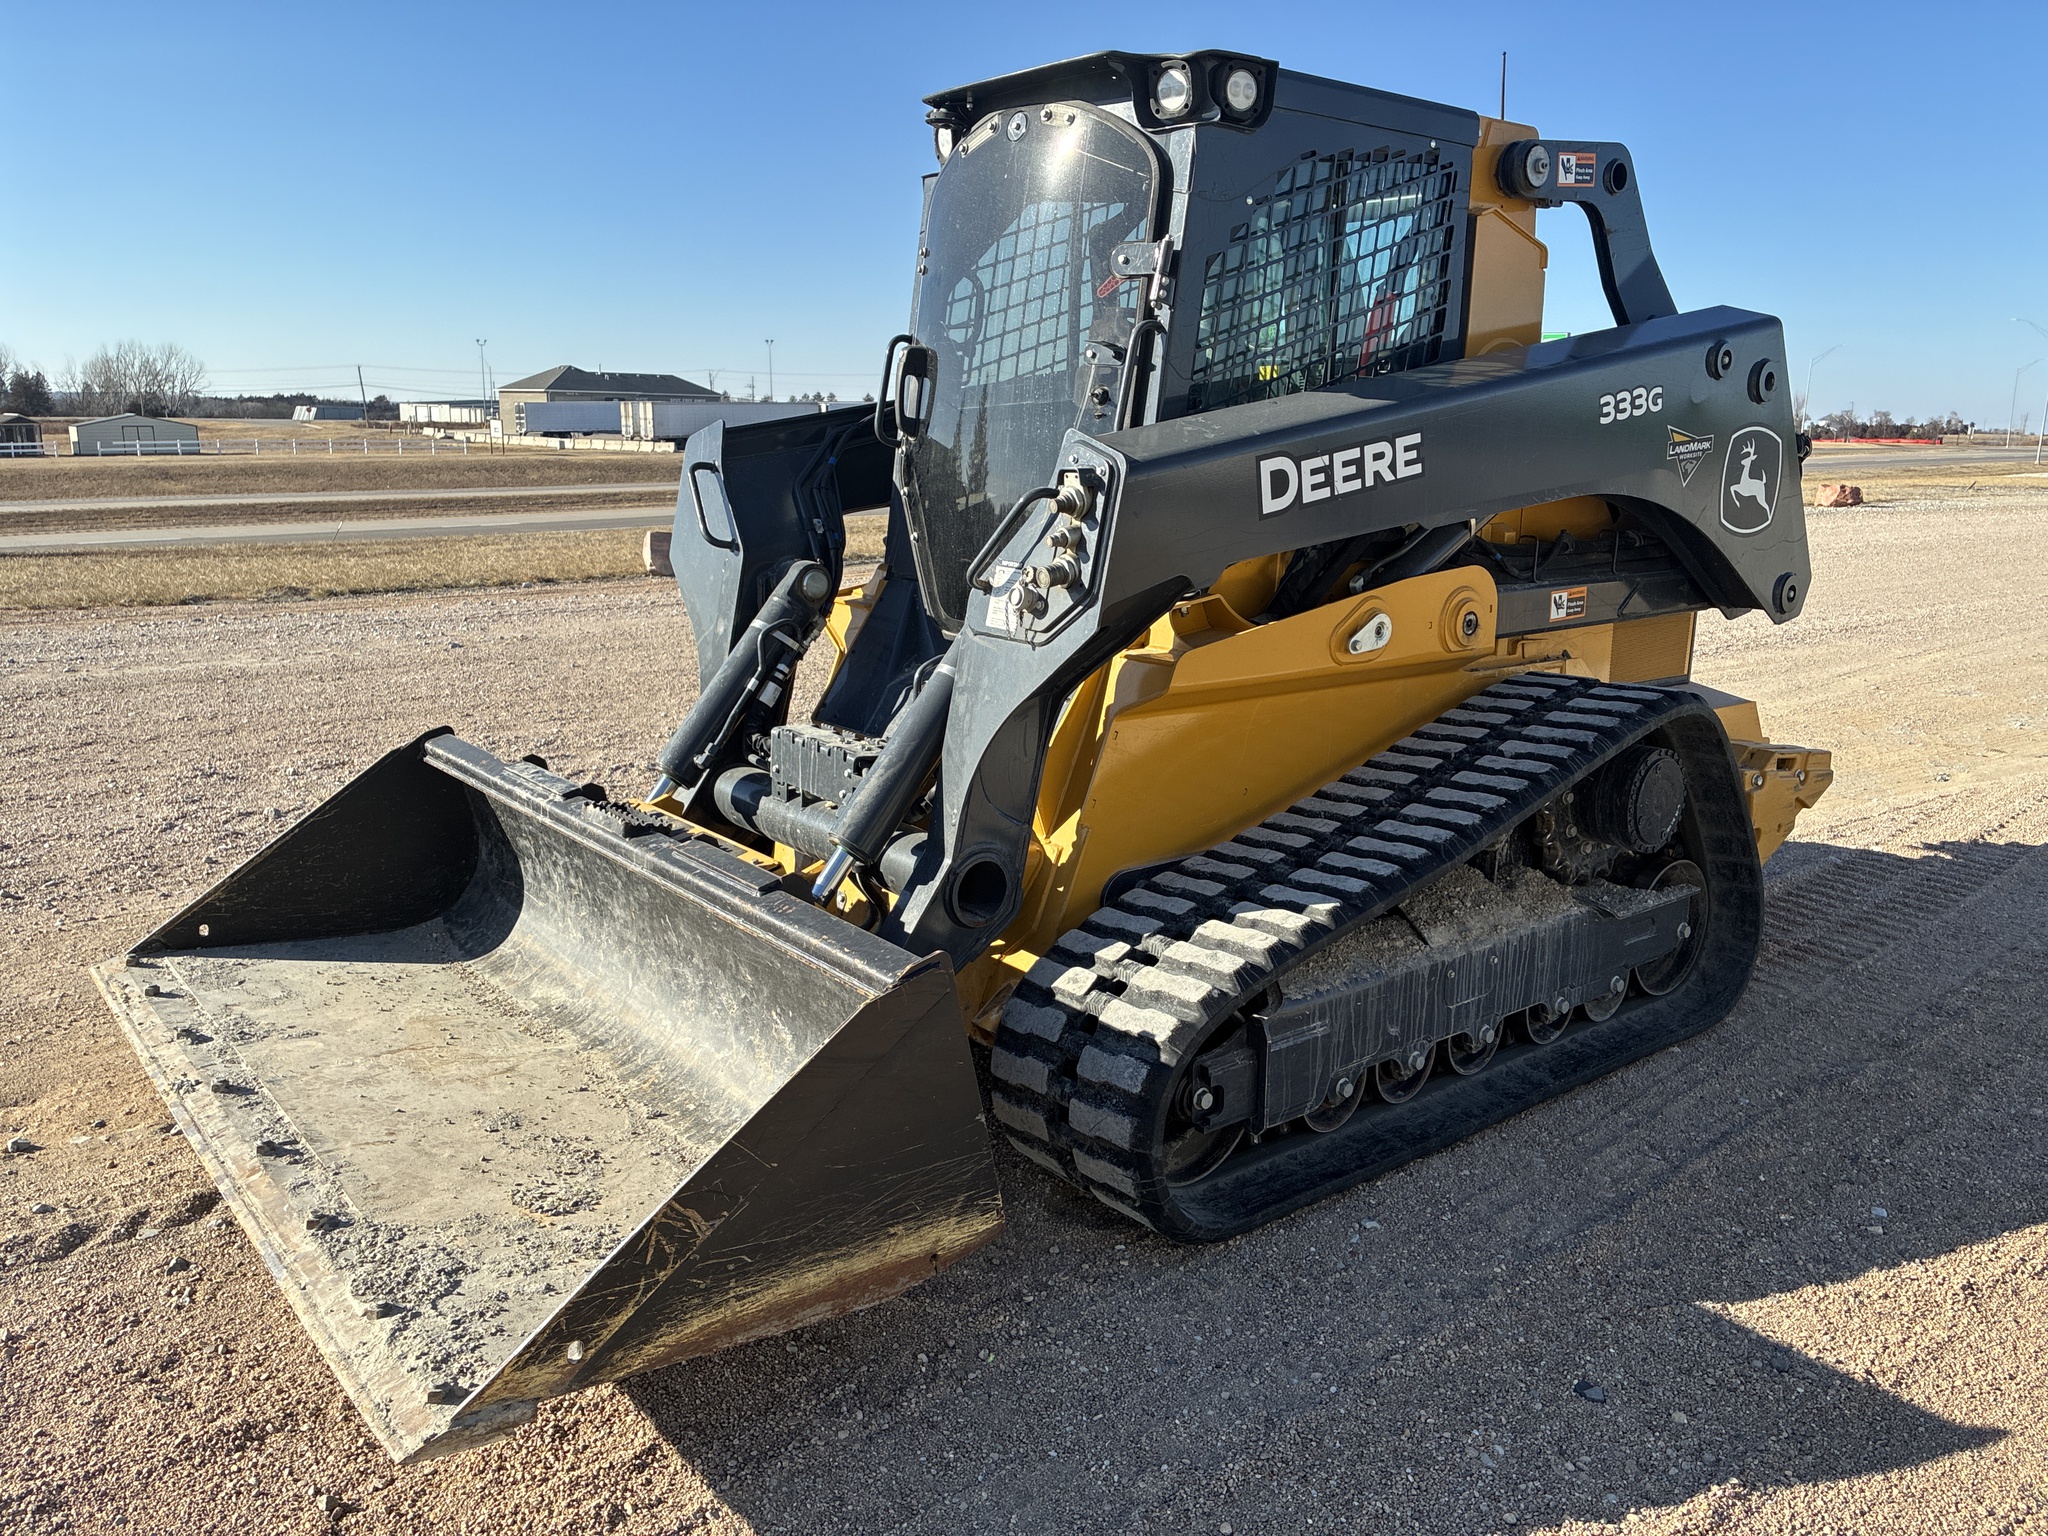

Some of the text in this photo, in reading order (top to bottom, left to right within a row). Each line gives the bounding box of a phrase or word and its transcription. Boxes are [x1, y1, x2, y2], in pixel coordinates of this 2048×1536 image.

[1599, 386, 1663, 425] 333G
[1669, 440, 1712, 455] LANDMARK
[1679, 451, 1703, 460] WORKSITE
[1260, 432, 1423, 515] DEERE
